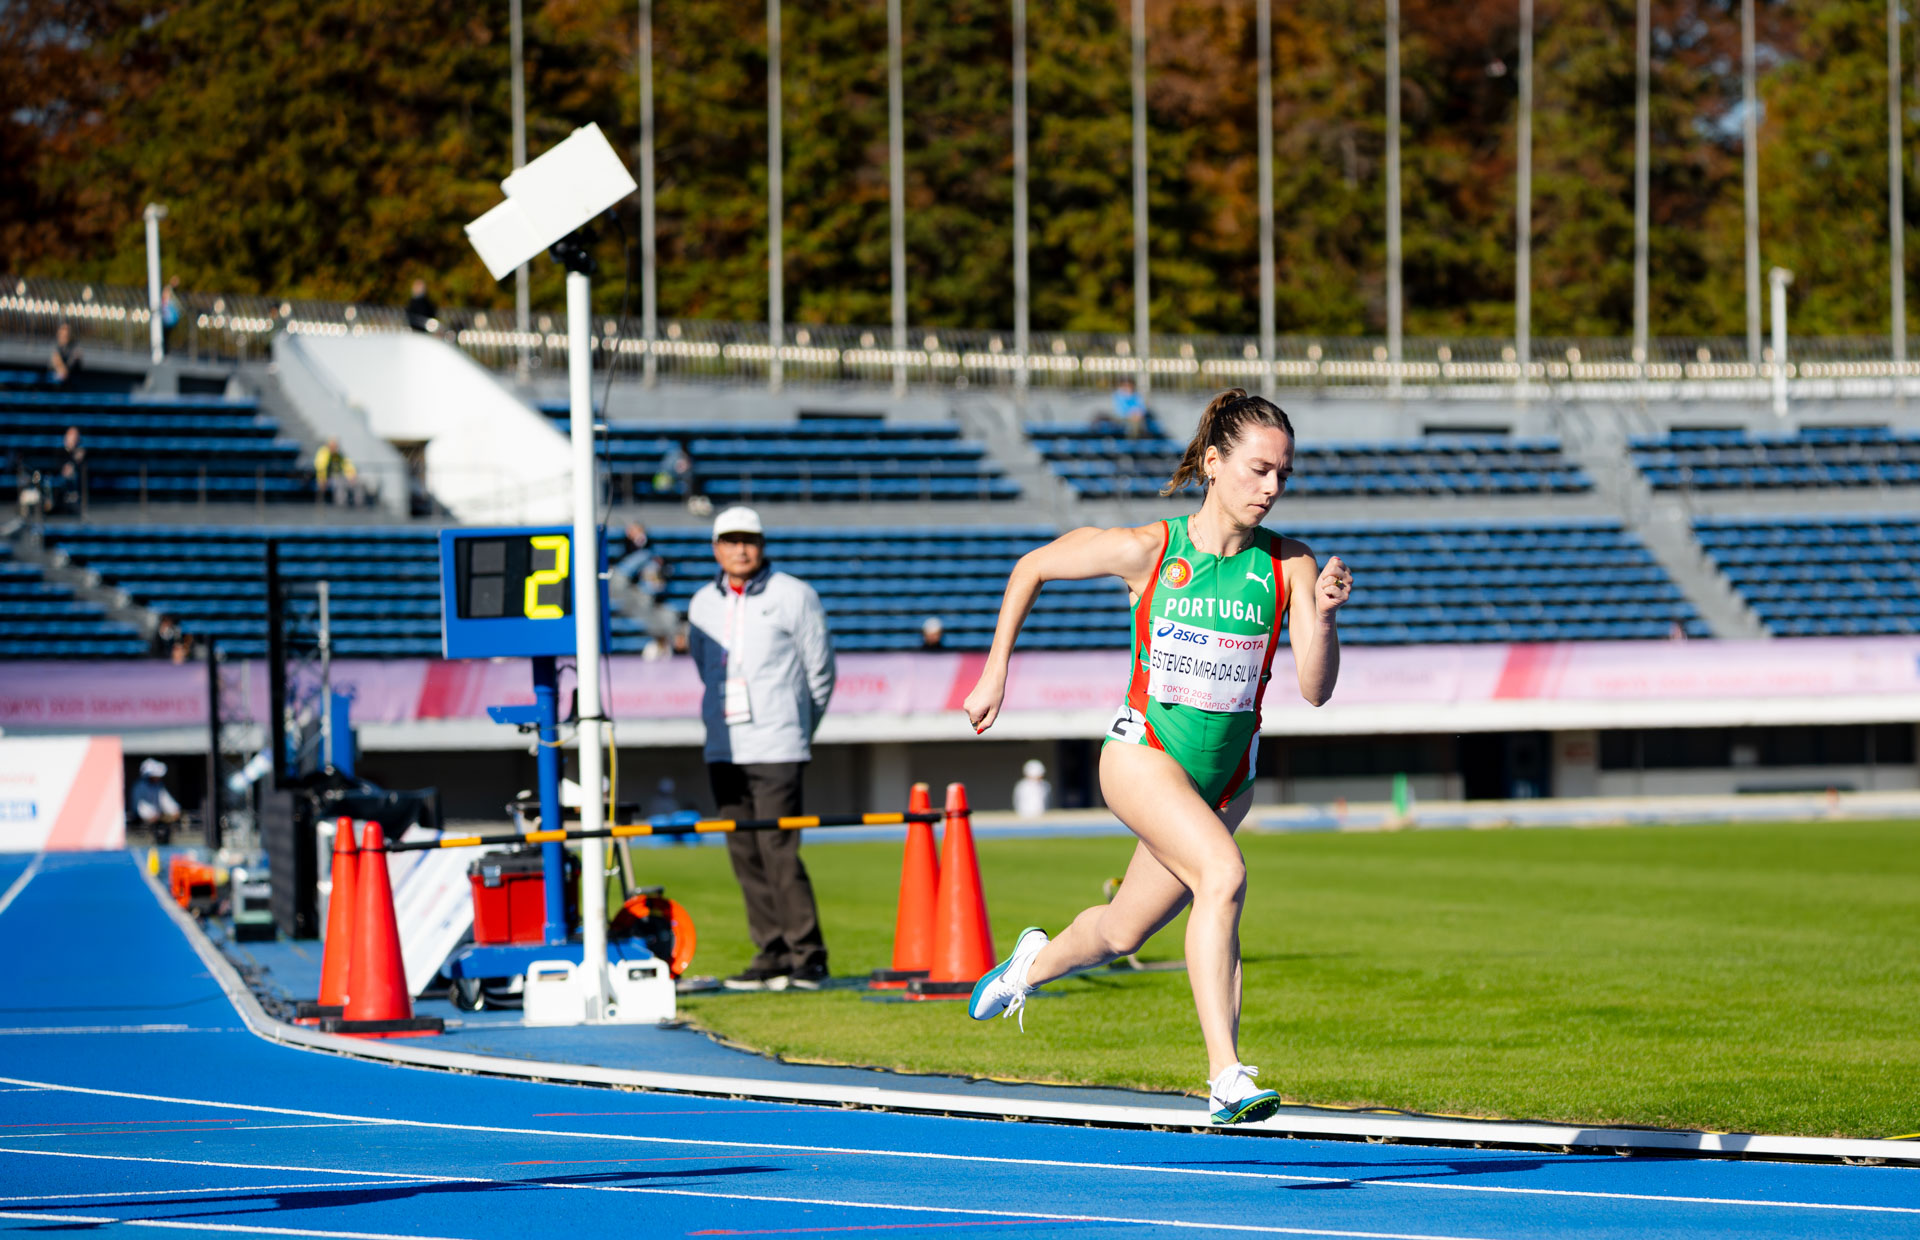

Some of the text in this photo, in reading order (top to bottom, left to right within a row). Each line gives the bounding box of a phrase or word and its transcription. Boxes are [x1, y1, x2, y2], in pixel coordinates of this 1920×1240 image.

[523, 535, 570, 620] 2
[1164, 597, 1264, 625] PORTUGAL
[1173, 628, 1209, 645] asics
[1217, 637, 1264, 651] TOYOTA
[1152, 649, 1259, 682] ESTEVES MIRA DA SILVA
[1162, 684, 1212, 700] TOKYO 2025
[1172, 694, 1231, 710] DEAFLYMPICS
